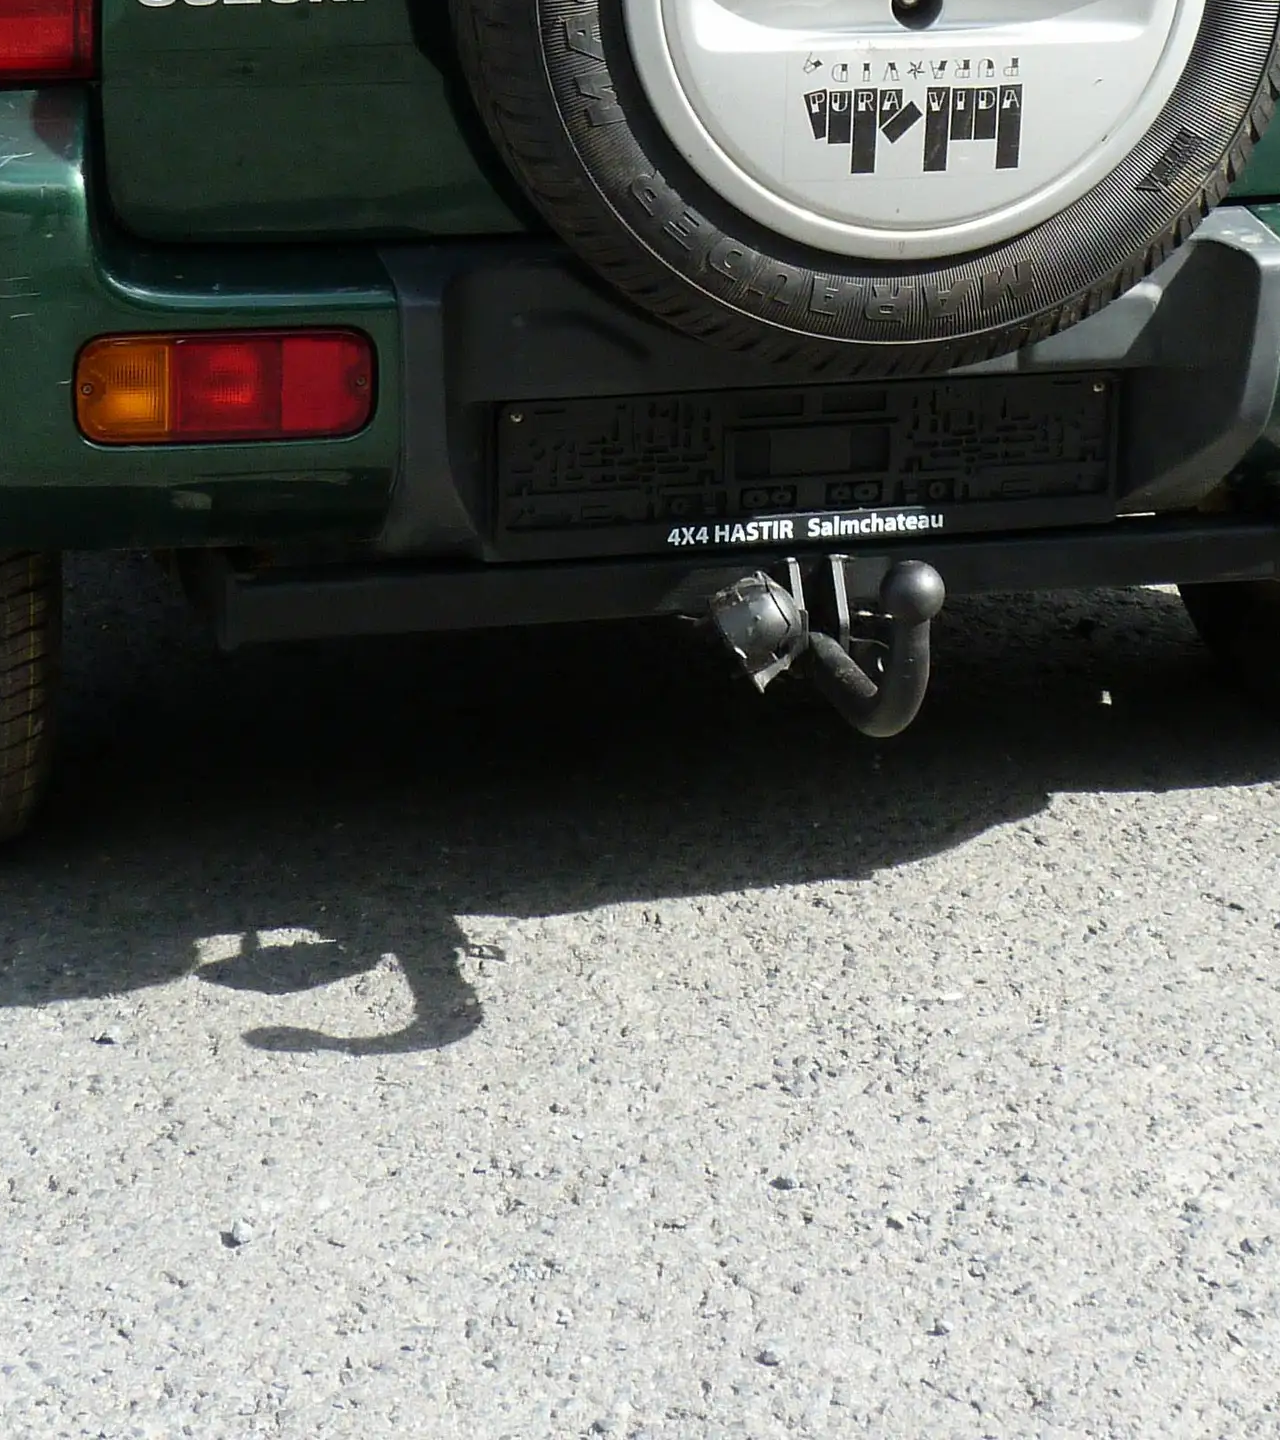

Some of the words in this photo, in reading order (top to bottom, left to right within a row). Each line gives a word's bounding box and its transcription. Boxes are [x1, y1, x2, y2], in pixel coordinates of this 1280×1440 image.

[808, 91, 901, 113] PURA
[928, 89, 1020, 111] VIDA
[667, 526, 709, 546] 4X4
[714, 520, 794, 544] HASTIR
[807, 513, 943, 538] Salmchateau
